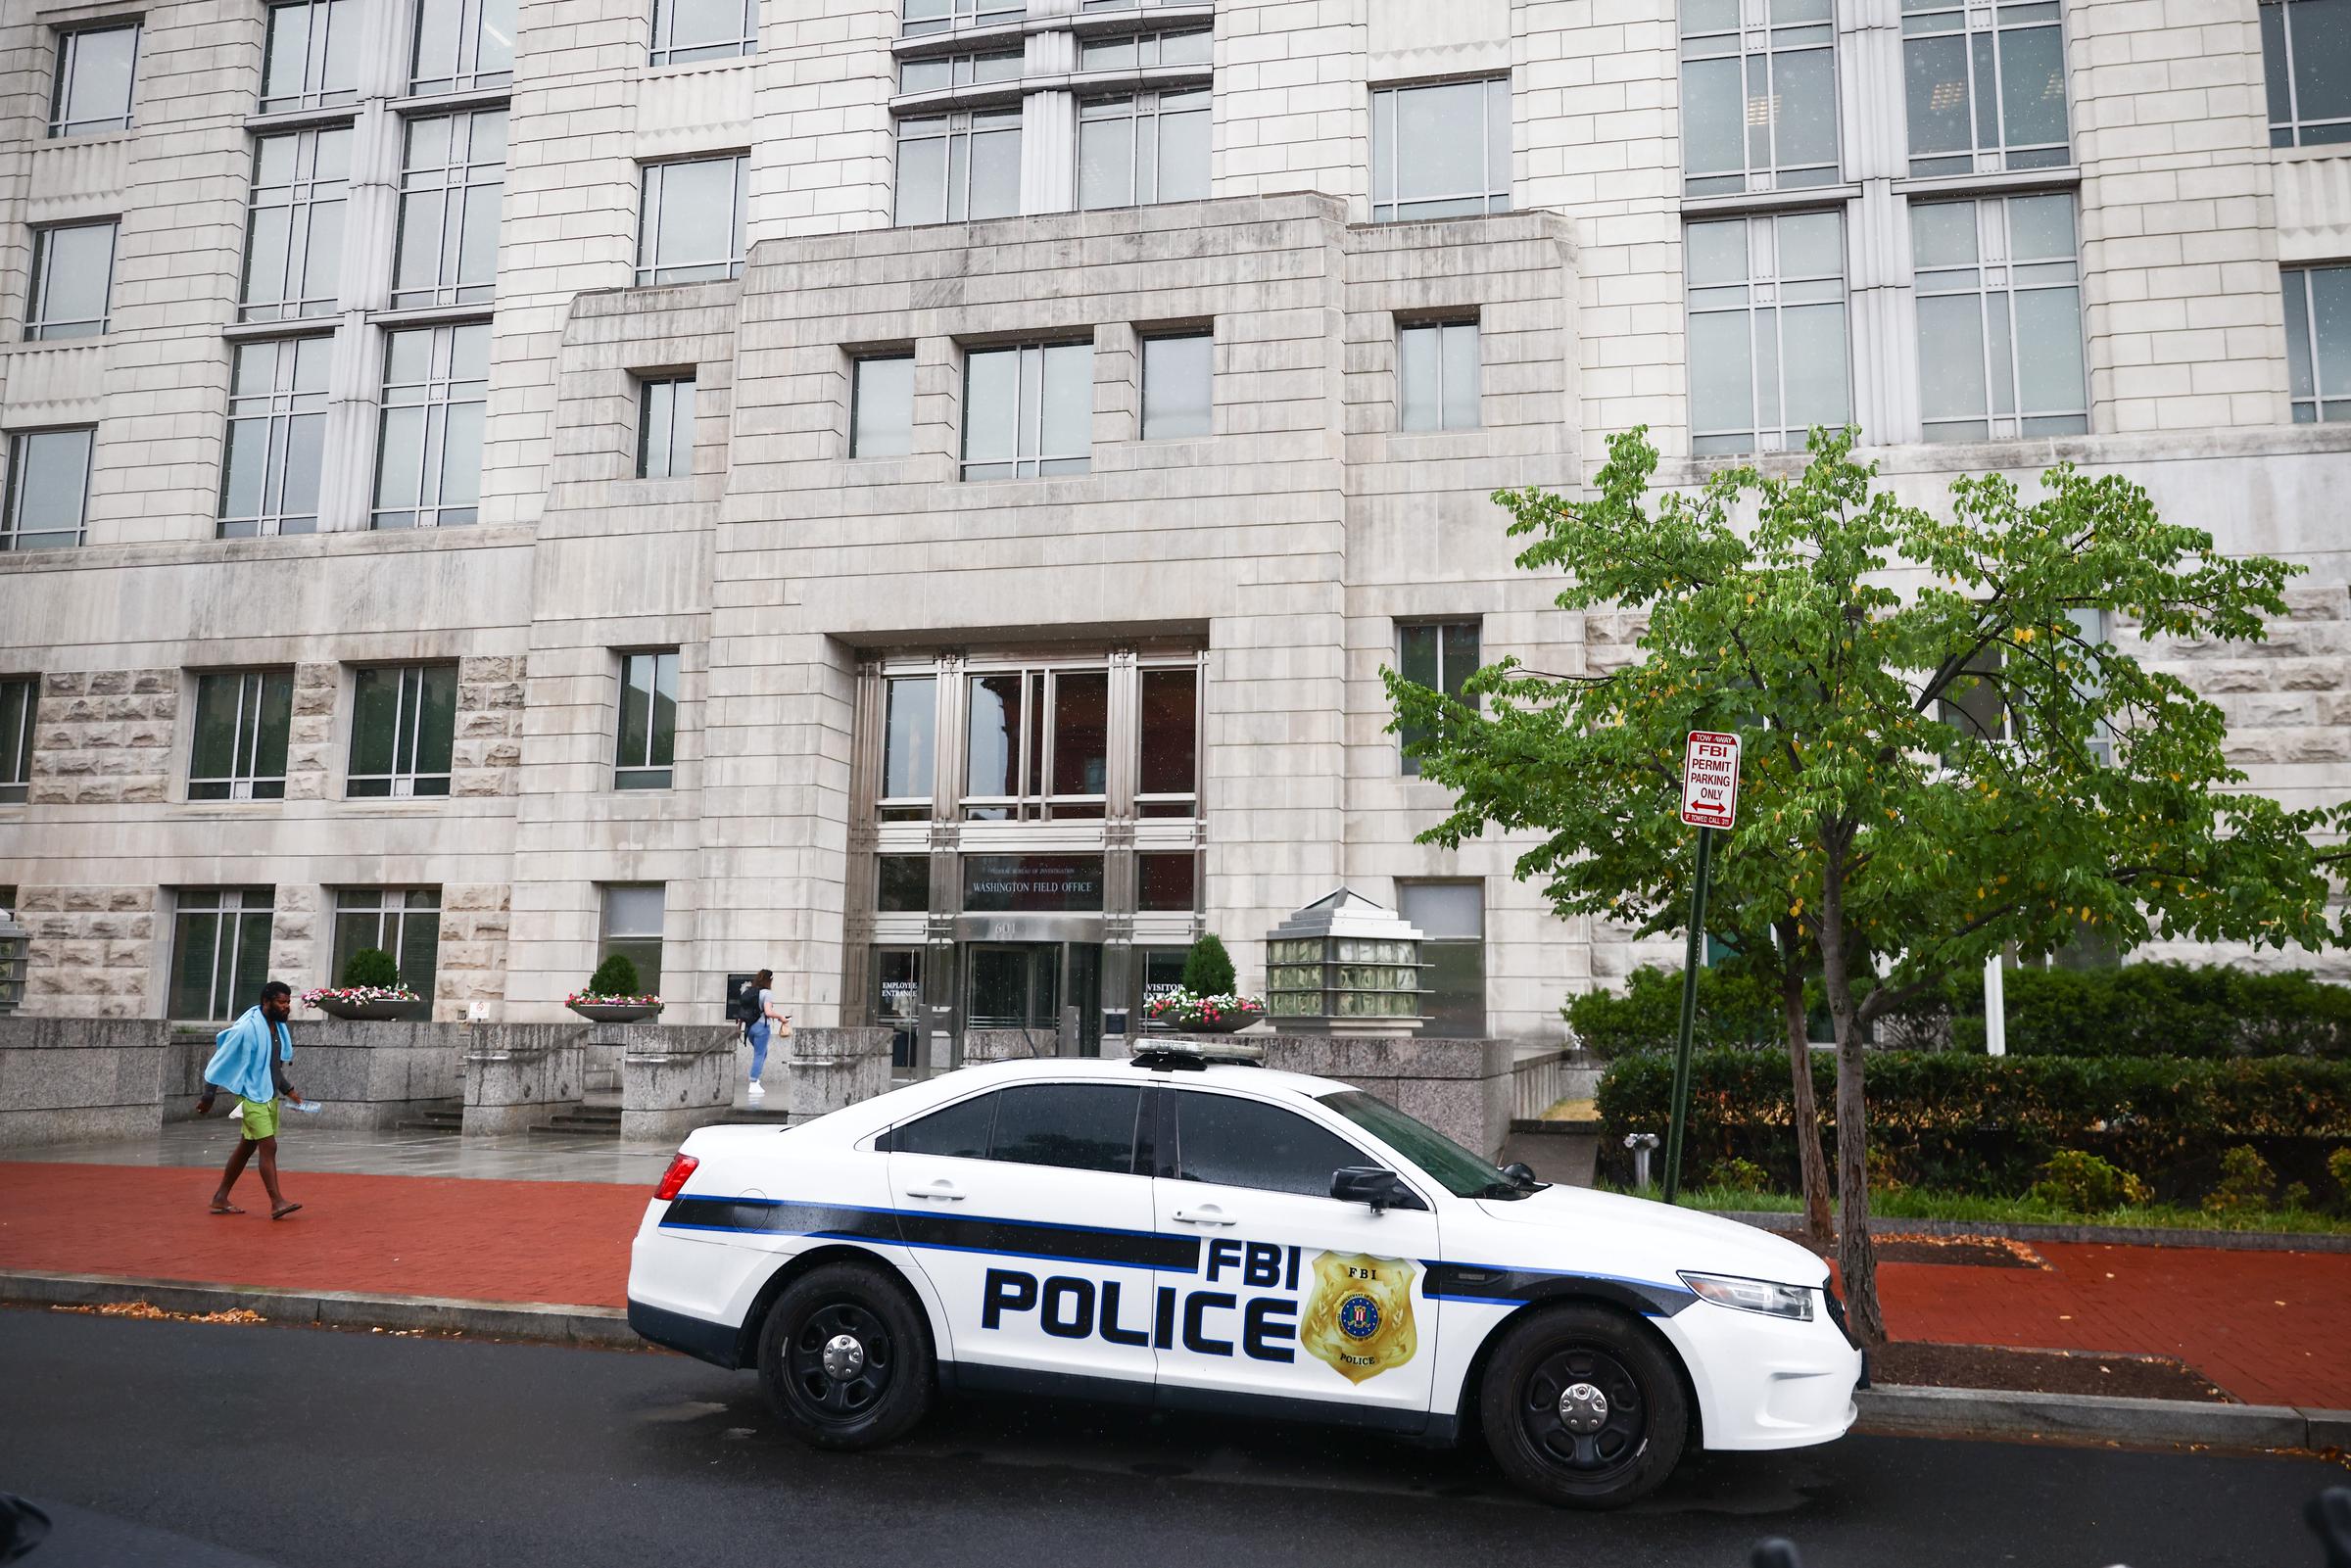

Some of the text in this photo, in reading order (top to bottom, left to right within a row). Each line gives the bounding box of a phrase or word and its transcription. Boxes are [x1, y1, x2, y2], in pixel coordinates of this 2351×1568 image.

[1699, 745, 1727, 757] FBI
[1692, 758, 1732, 772] PERMIT
[1691, 773, 1731, 786] PARKING
[1701, 787, 1723, 800] ONLY
[973, 881, 1092, 893] WASHINGTON FIELD OFFICE
[995, 924, 1016, 933] 601
[1206, 1238, 1301, 1290] FBI
[1348, 1266, 1377, 1280] FBI
[982, 1267, 1298, 1363] POLICE
[1340, 1353, 1375, 1365] POLICE
